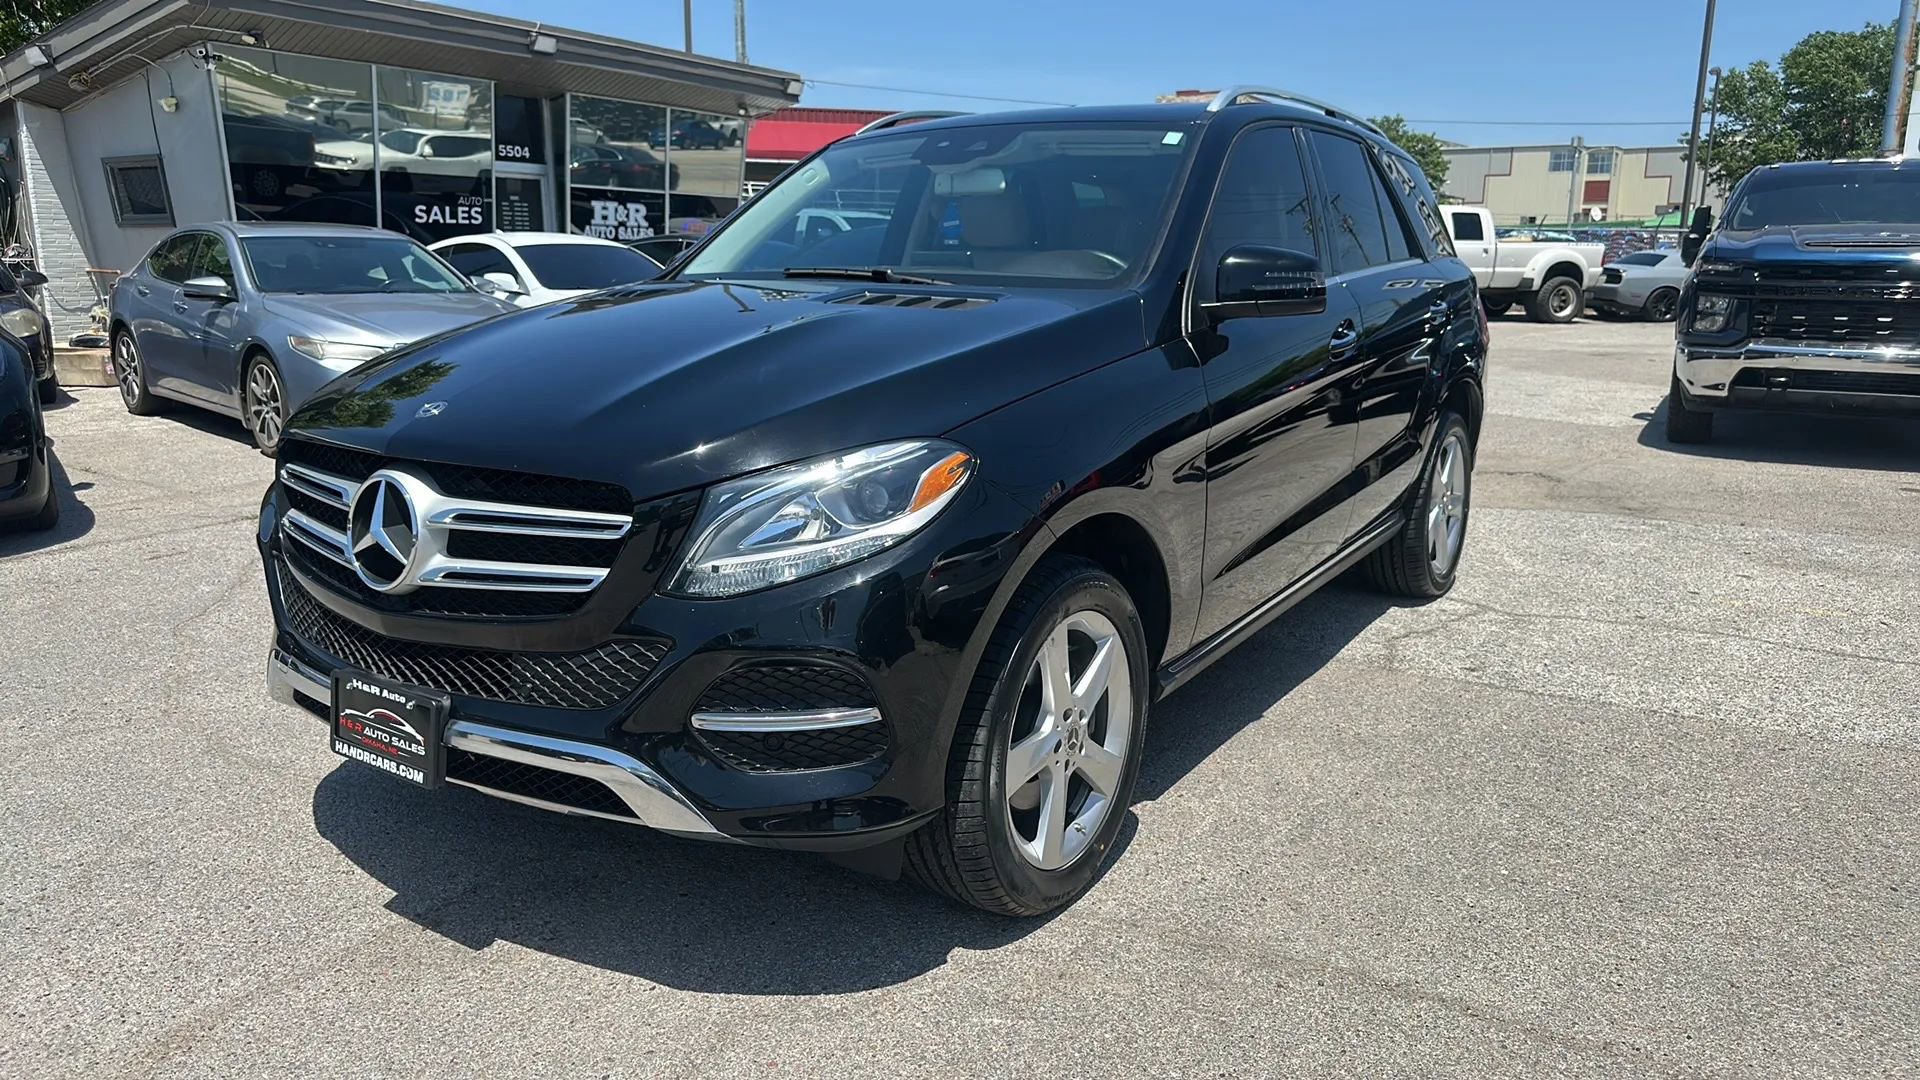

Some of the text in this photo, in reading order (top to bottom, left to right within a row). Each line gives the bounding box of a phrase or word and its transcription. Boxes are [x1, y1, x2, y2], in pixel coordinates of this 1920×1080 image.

[498, 144, 530, 158] 5504
[458, 196, 483, 206] AUTO
[414, 204, 483, 225] SALES
[591, 200, 649, 227] H&R
[584, 225, 655, 240] AUTO SALES
[352, 678, 406, 703] H&R Auto
[363, 726, 390, 742] AUTO
[391, 736, 426, 756] SALES
[335, 740, 424, 784] HANDRCARS.COM
